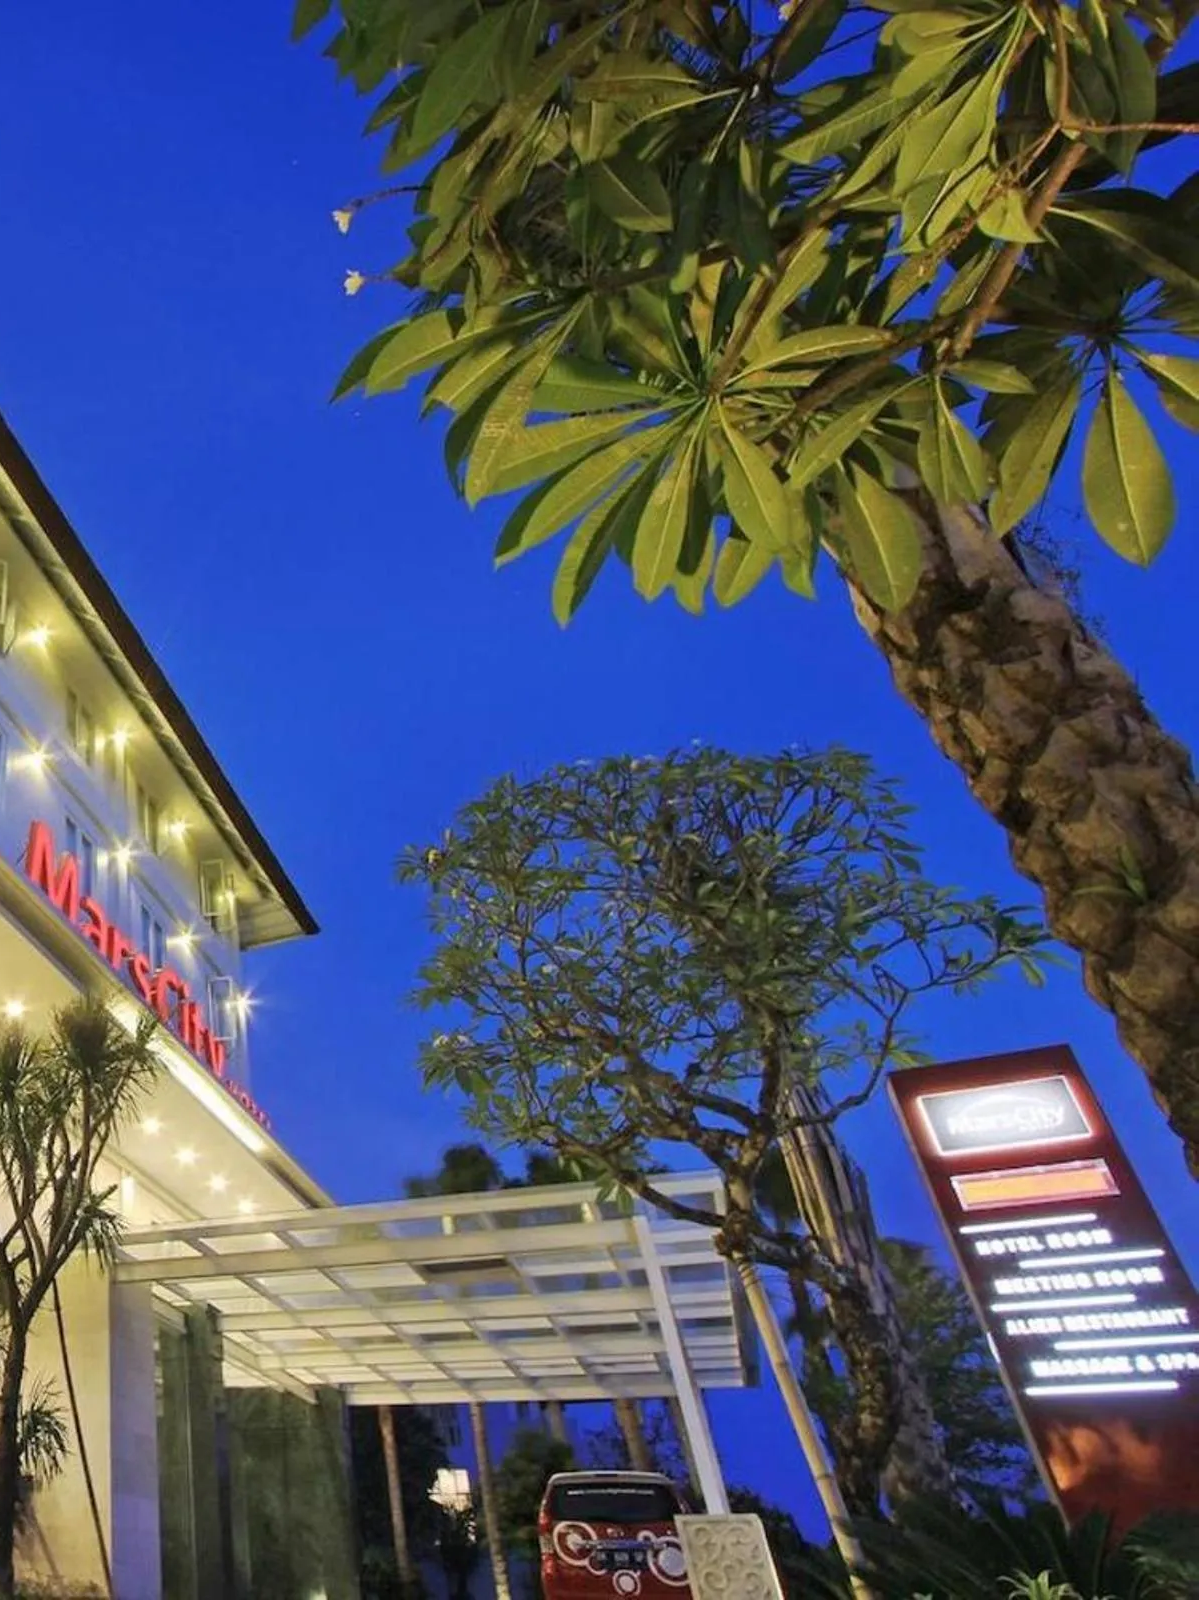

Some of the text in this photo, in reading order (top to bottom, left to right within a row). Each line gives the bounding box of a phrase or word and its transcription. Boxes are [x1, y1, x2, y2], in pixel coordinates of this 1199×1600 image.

[26, 819, 226, 1077] MarsCity
[975, 1229, 1112, 1255] HOTEL ROOM
[994, 1267, 1163, 1295] MEETING ROOM
[1062, 1308, 1189, 1332] RESTAURANT
[1030, 1356, 1134, 1377] MASSAGE
[1135, 1355, 1155, 1372] &
